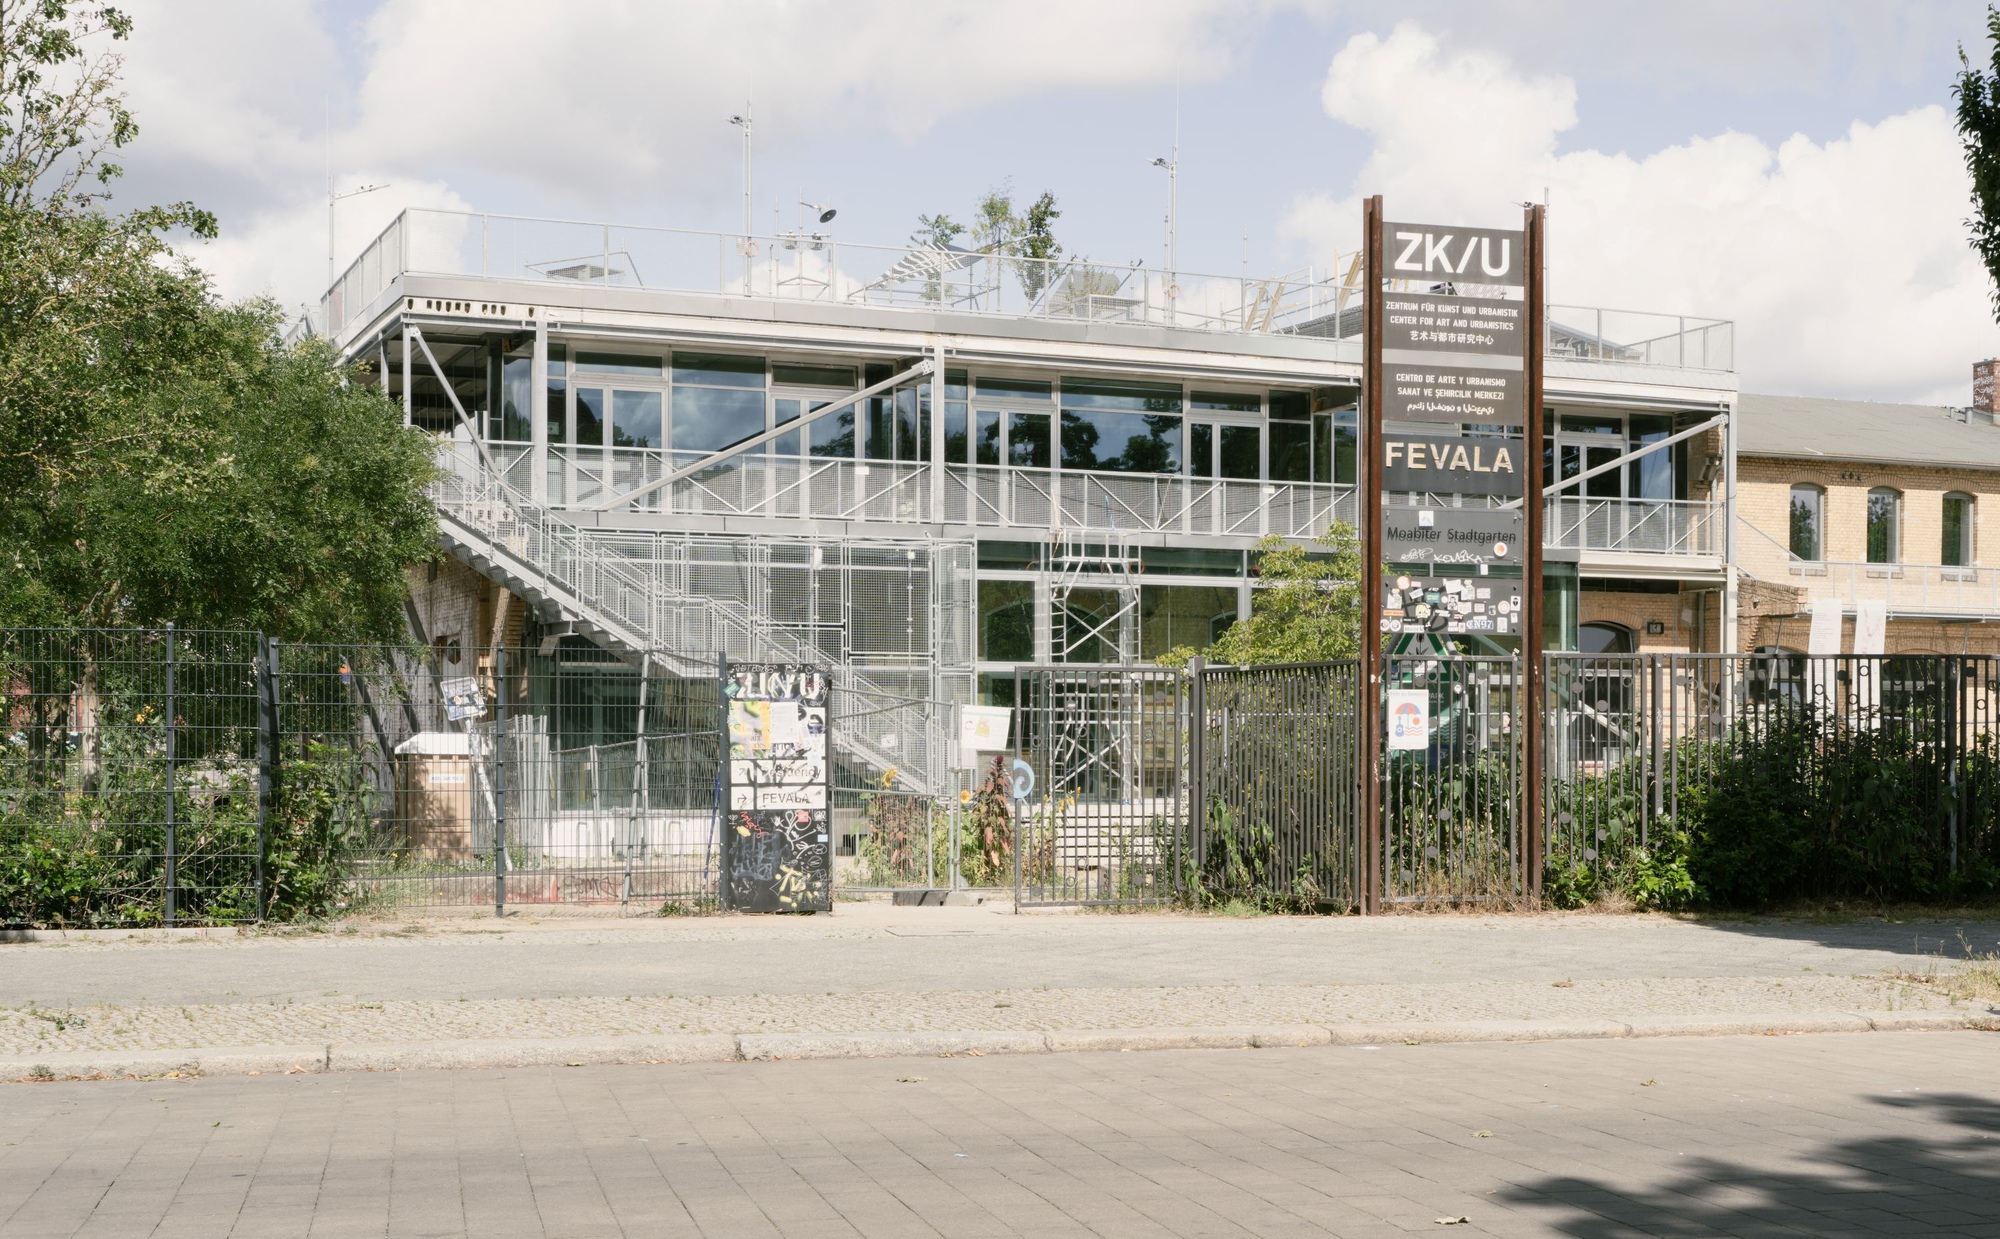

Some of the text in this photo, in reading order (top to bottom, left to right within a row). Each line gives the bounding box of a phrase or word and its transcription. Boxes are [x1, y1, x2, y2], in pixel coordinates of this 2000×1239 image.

[1394, 231, 1511, 277] ZK/U
[1385, 301, 1519, 317] ZENTRUM FÜR KUNST UND URBANISTIK
[1390, 315, 1514, 331] CENTER FOR ART AND URBANISTICS
[1410, 330, 1494, 345] 艺术与都市研究中心
[1396, 373, 1506, 387] CENTRO DE ARTE Y URBANISMO
[1397, 387, 1420, 396] SANAT
[1423, 388, 1433, 397] VE
[1385, 441, 1515, 474] FEVALA
[1387, 527, 1517, 544] Moabiter Stadtgarten
[762, 793, 810, 804] FEVALA
